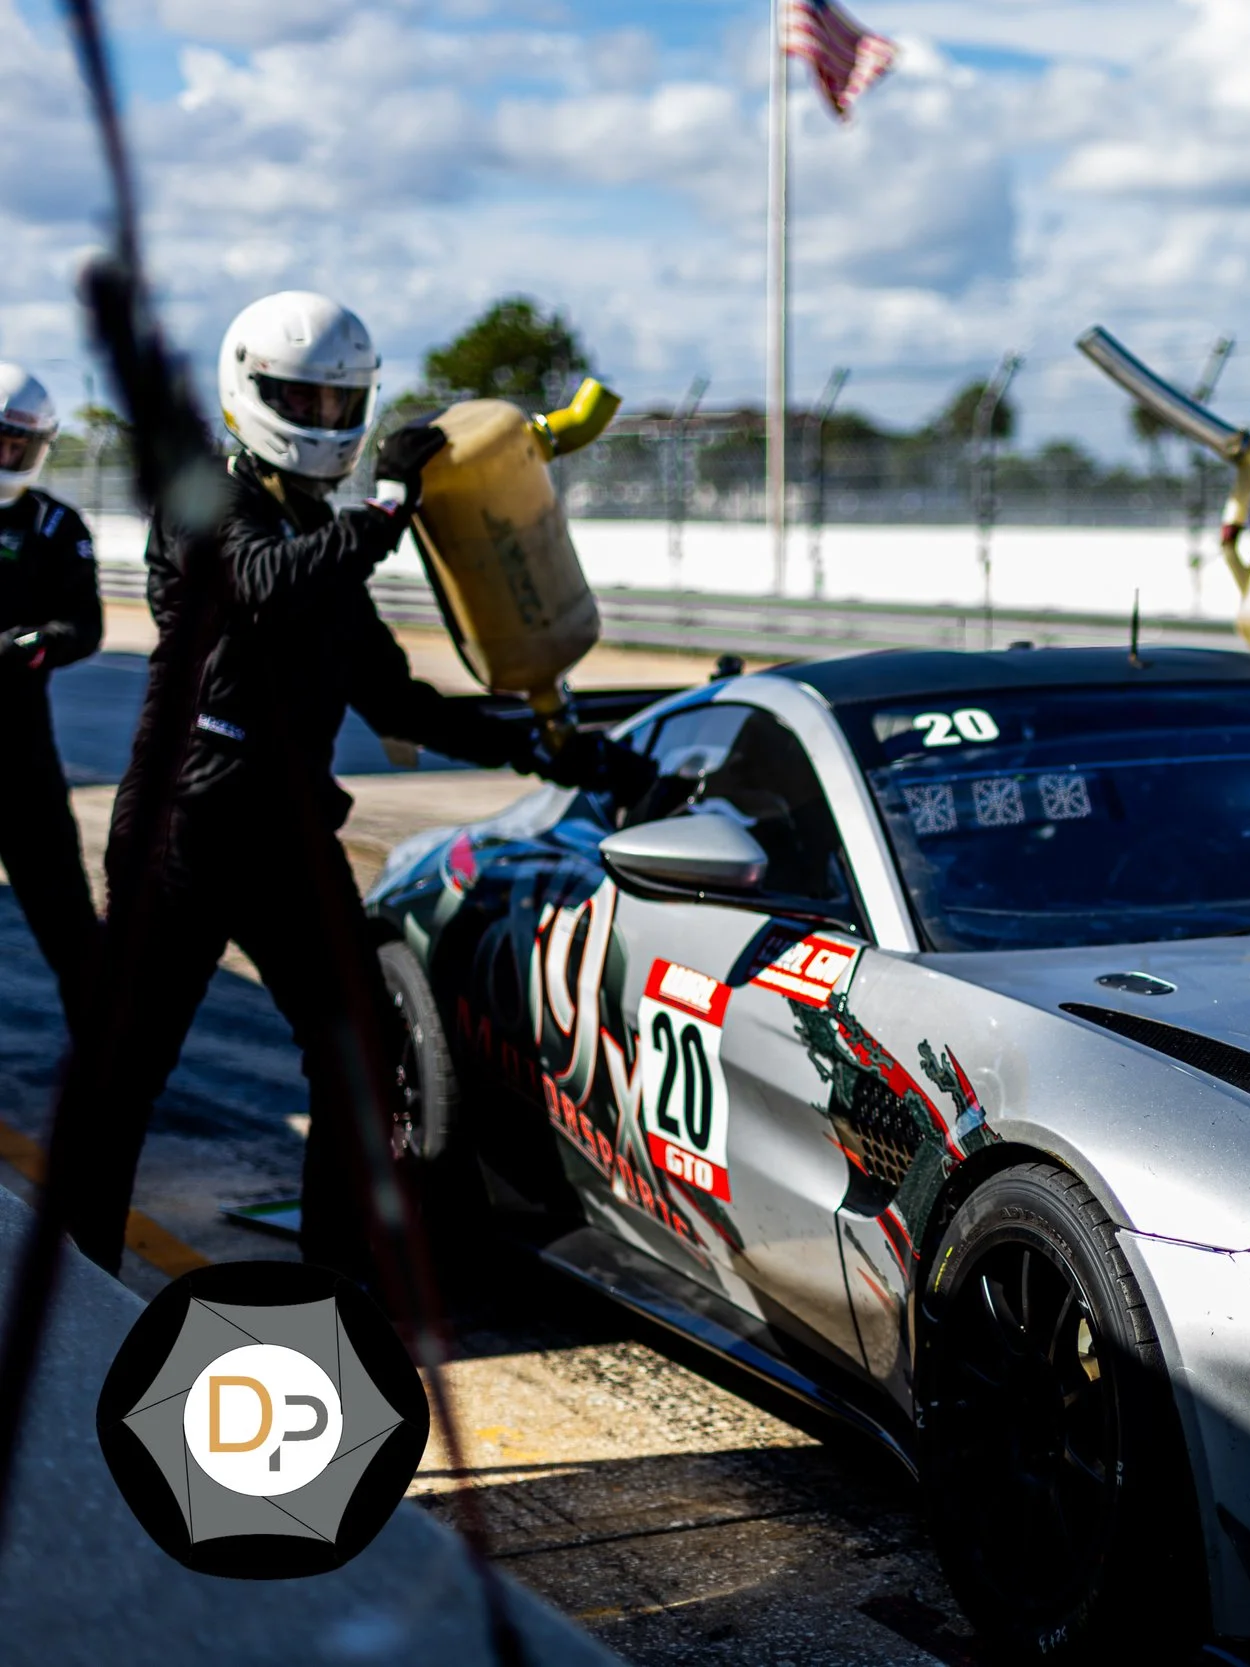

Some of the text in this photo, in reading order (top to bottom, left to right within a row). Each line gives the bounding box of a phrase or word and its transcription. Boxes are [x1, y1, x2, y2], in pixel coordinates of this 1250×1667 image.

[912, 708, 1000, 747] 20
[652, 1010, 713, 1151] 20
[665, 1143, 713, 1191] GTO
